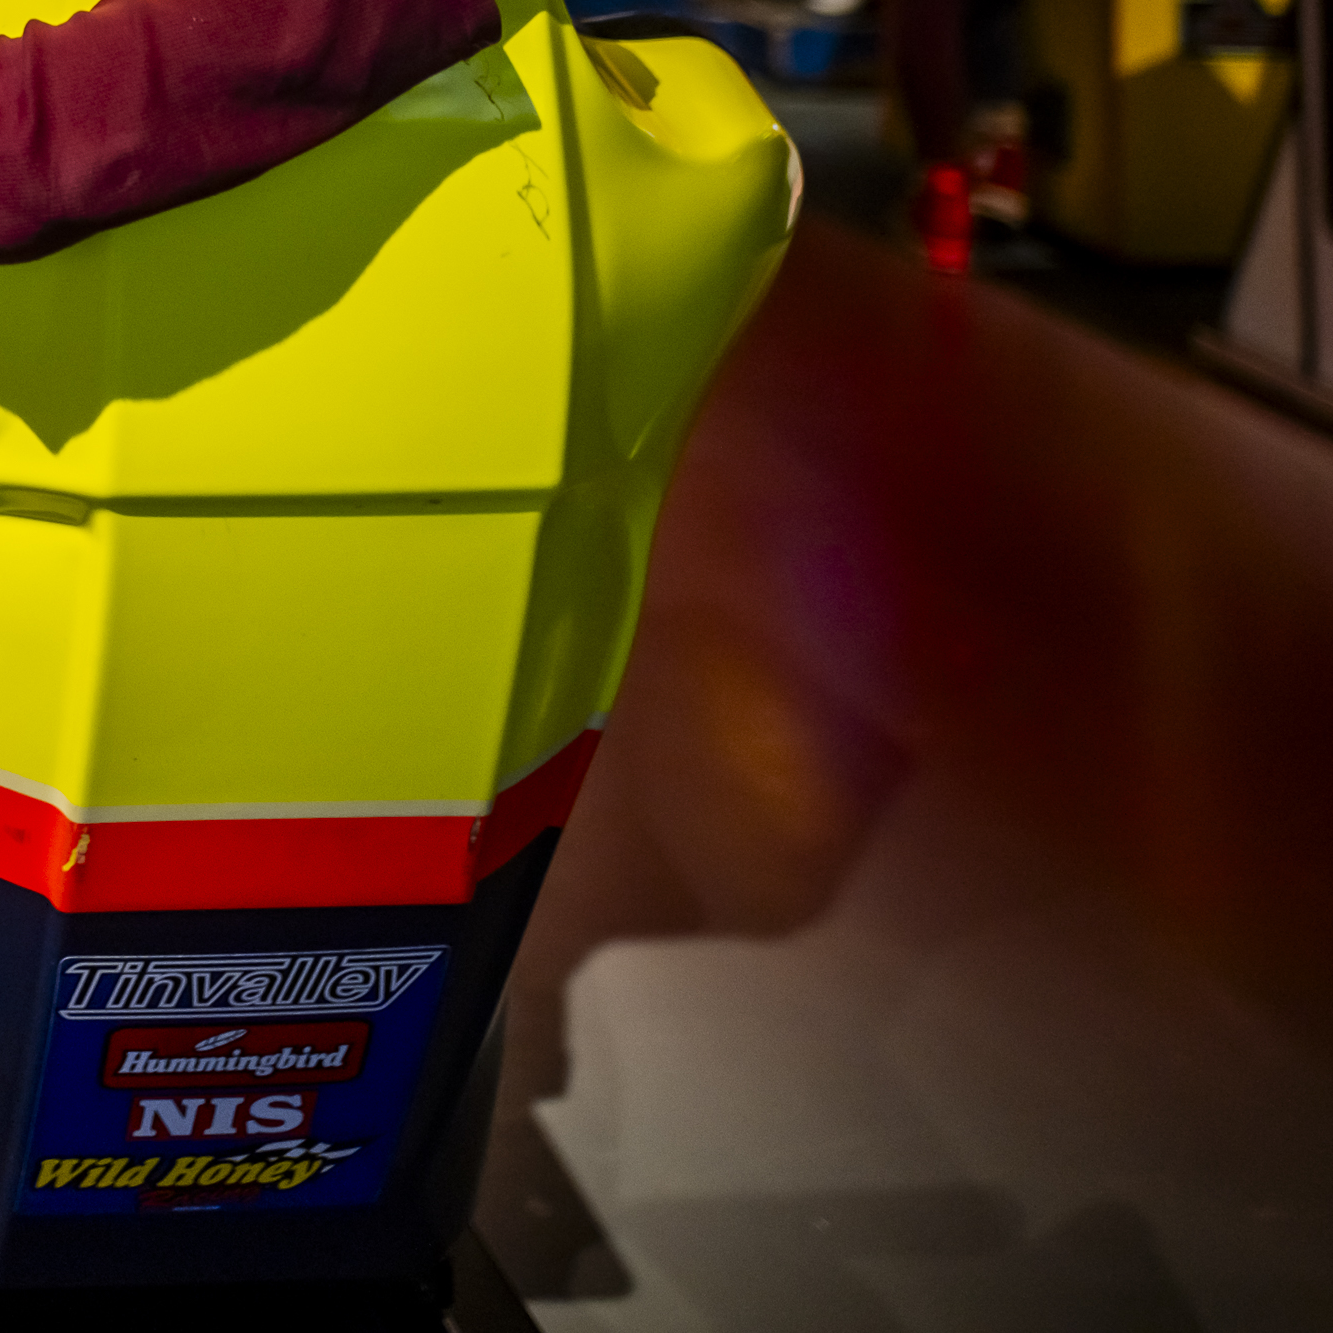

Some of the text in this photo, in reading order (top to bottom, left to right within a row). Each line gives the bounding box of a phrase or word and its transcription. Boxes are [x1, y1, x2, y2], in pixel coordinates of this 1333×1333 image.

[60, 949, 443, 1020] Tinvalley
[117, 1044, 350, 1077] Hummingbird
[132, 1093, 306, 1138] NIS
[34, 1155, 324, 1190] Wild Honey
